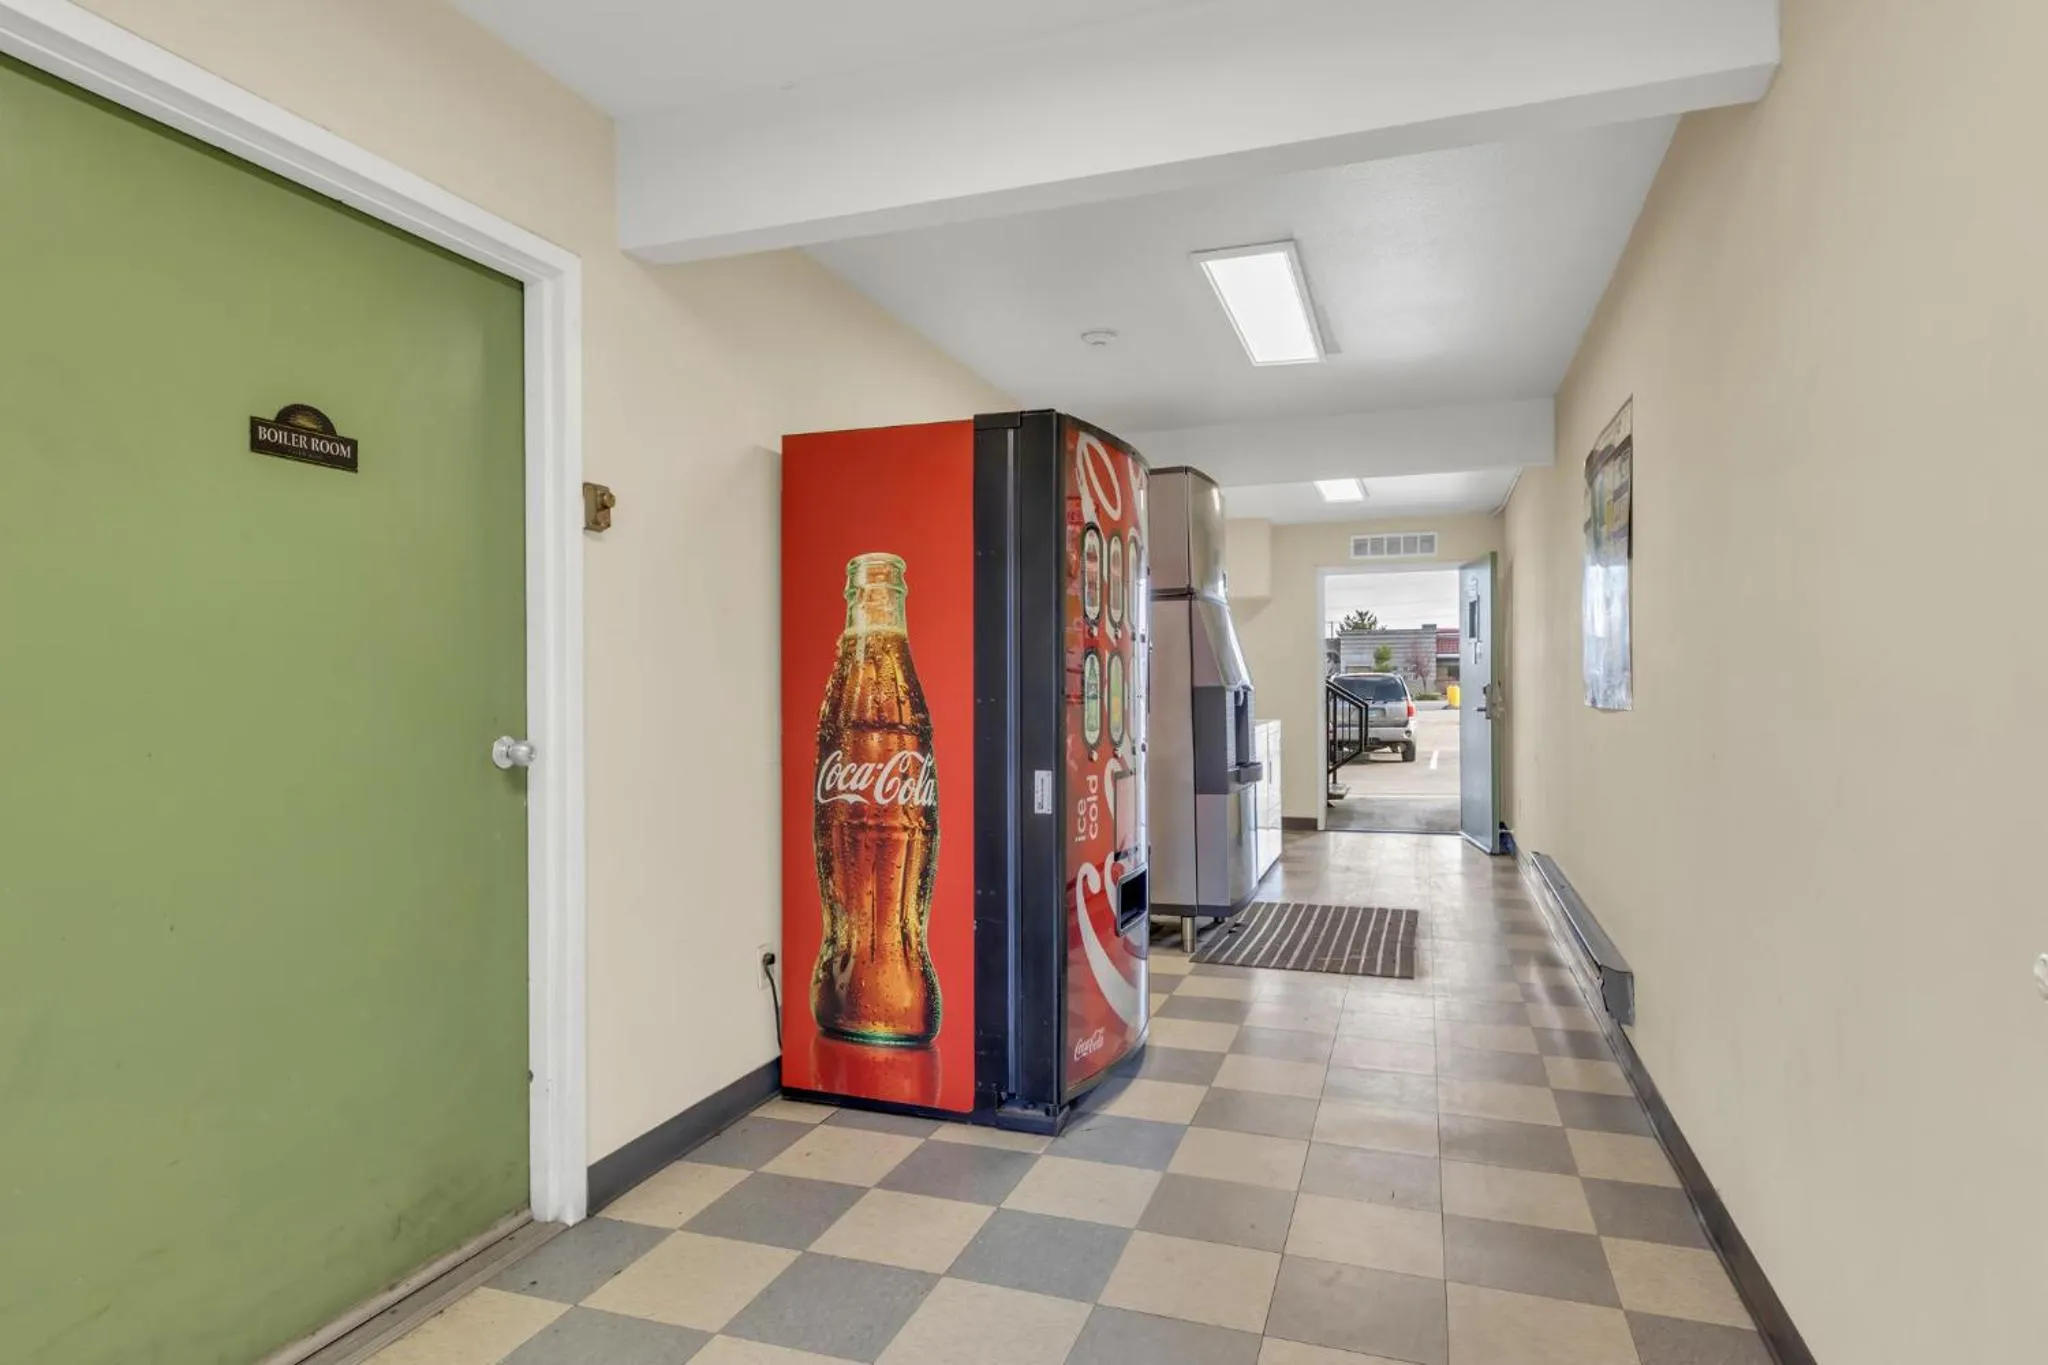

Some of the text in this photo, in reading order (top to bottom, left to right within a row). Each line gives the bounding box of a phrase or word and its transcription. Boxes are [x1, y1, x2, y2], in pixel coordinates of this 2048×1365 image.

[258, 426, 308, 449] BOILER
[311, 438, 351, 458] ROOM
[1075, 798, 1087, 842] ice
[1086, 774, 1099, 840] cold
